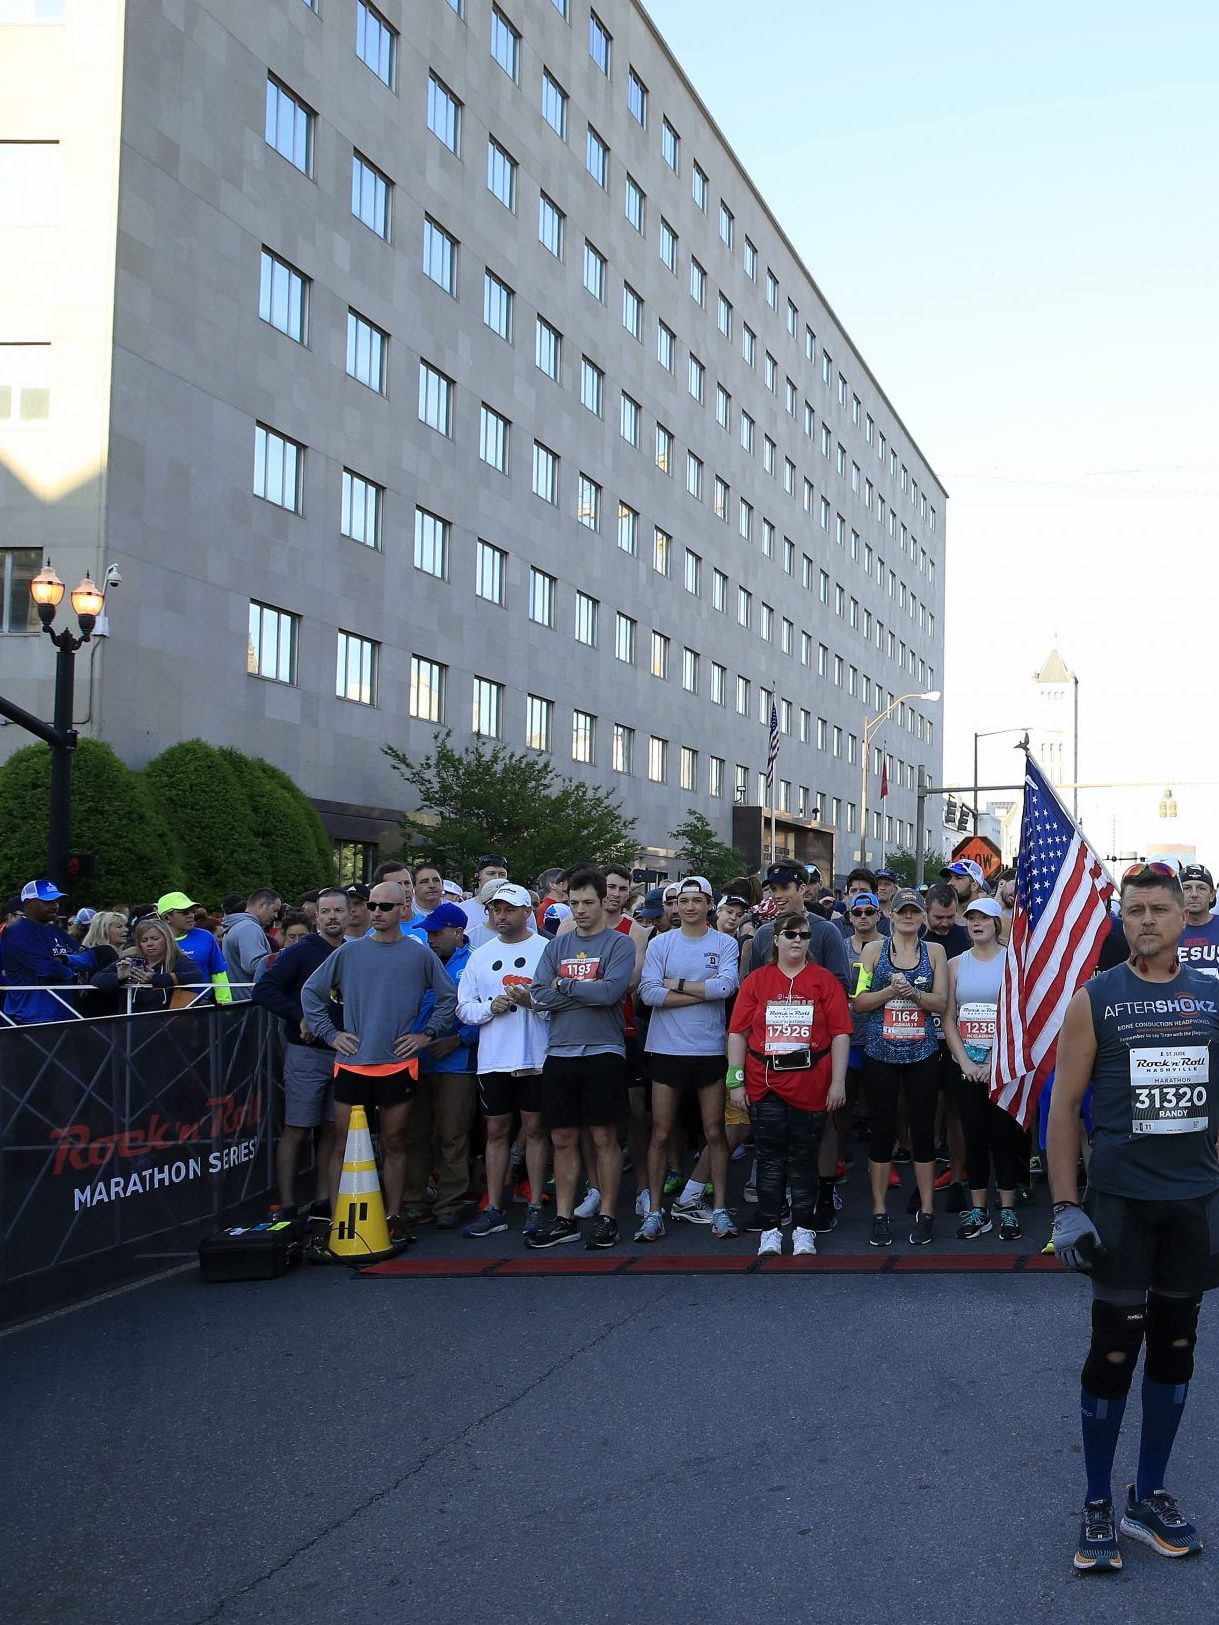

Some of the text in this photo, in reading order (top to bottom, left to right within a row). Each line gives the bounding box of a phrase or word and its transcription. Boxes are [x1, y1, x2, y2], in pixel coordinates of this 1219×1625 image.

[709, 956, 716, 965] D
[567, 963, 591, 975] 1193
[1104, 998, 1217, 1020] AFTERSHOKZ
[891, 1010, 919, 1022] 1164
[767, 1025, 810, 1037] 17926
[966, 1022, 995, 1034] 1238
[1117, 1023, 1134, 1032] BONE
[1135, 1086, 1207, 1109] 31320
[1159, 1109, 1189, 1118] RANDY
[49, 1114, 175, 1176] Rock
[73, 1156, 201, 1212] MARATHON
